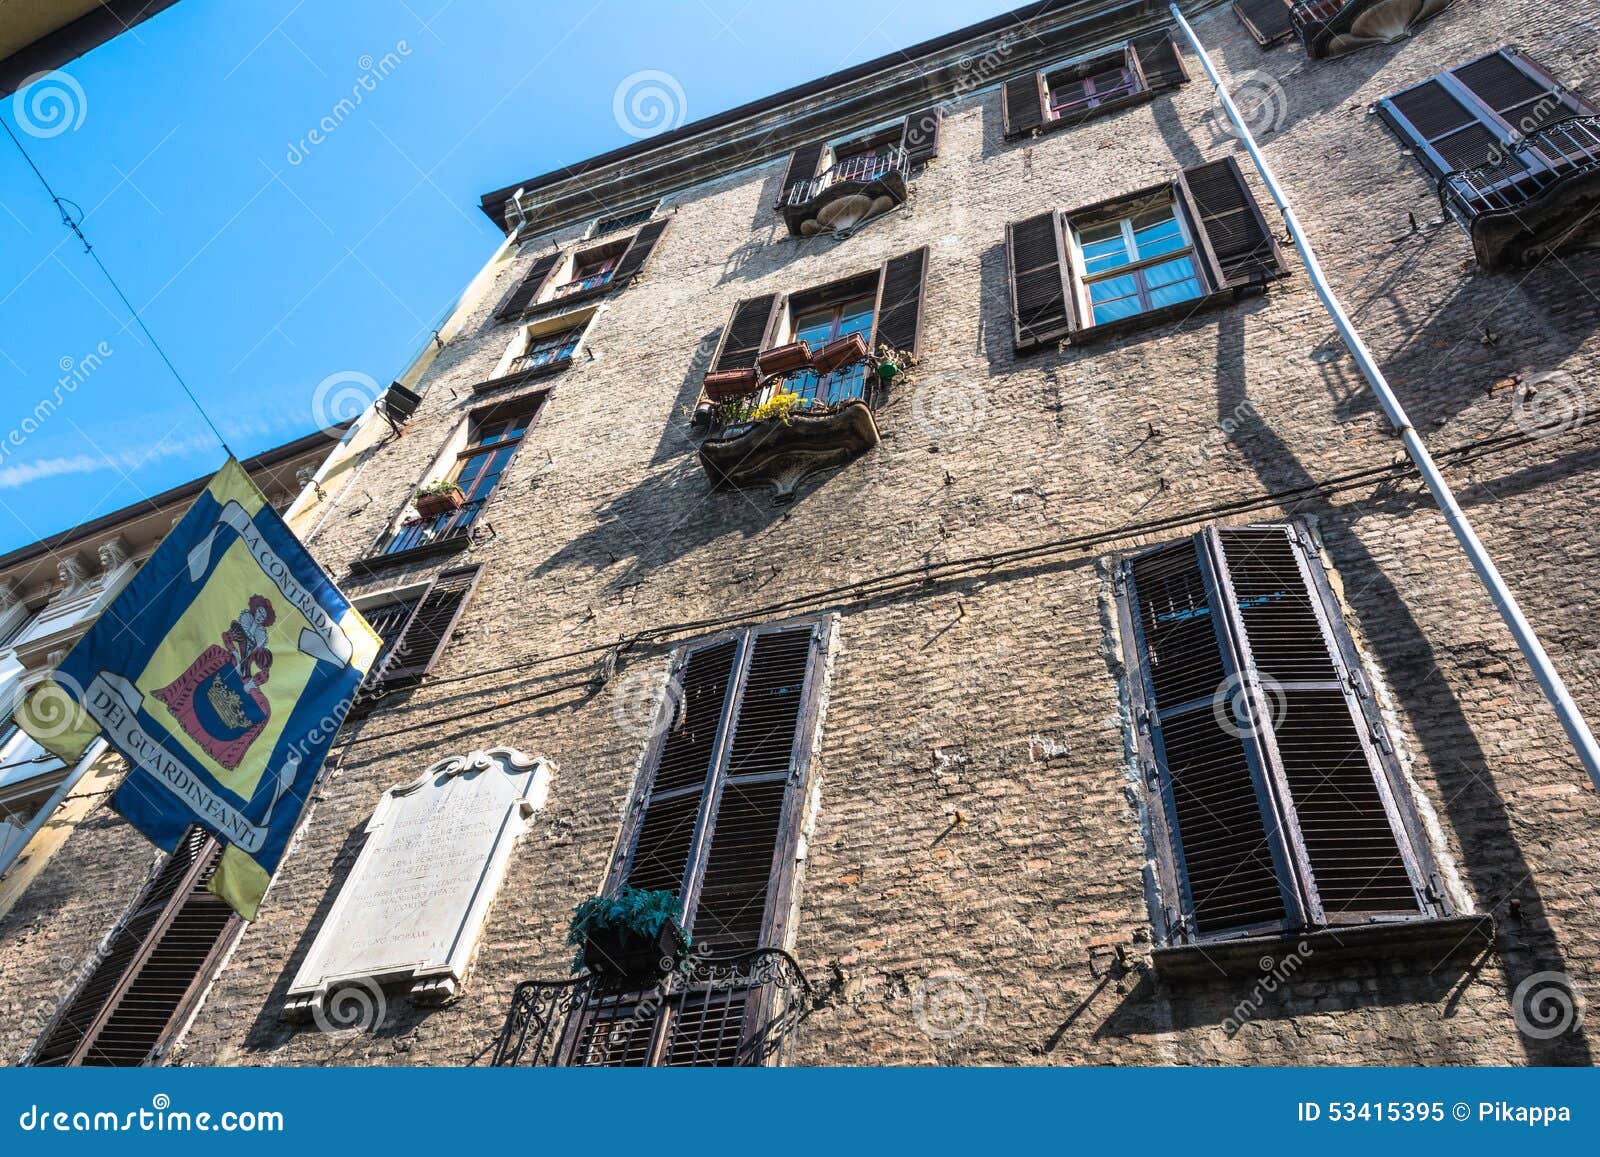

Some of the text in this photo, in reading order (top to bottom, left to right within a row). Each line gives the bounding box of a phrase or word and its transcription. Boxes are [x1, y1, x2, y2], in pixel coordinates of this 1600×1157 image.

[241, 521, 334, 639] LA CONTRADA
[92, 692, 257, 847] DEI GUARDINFANTI
